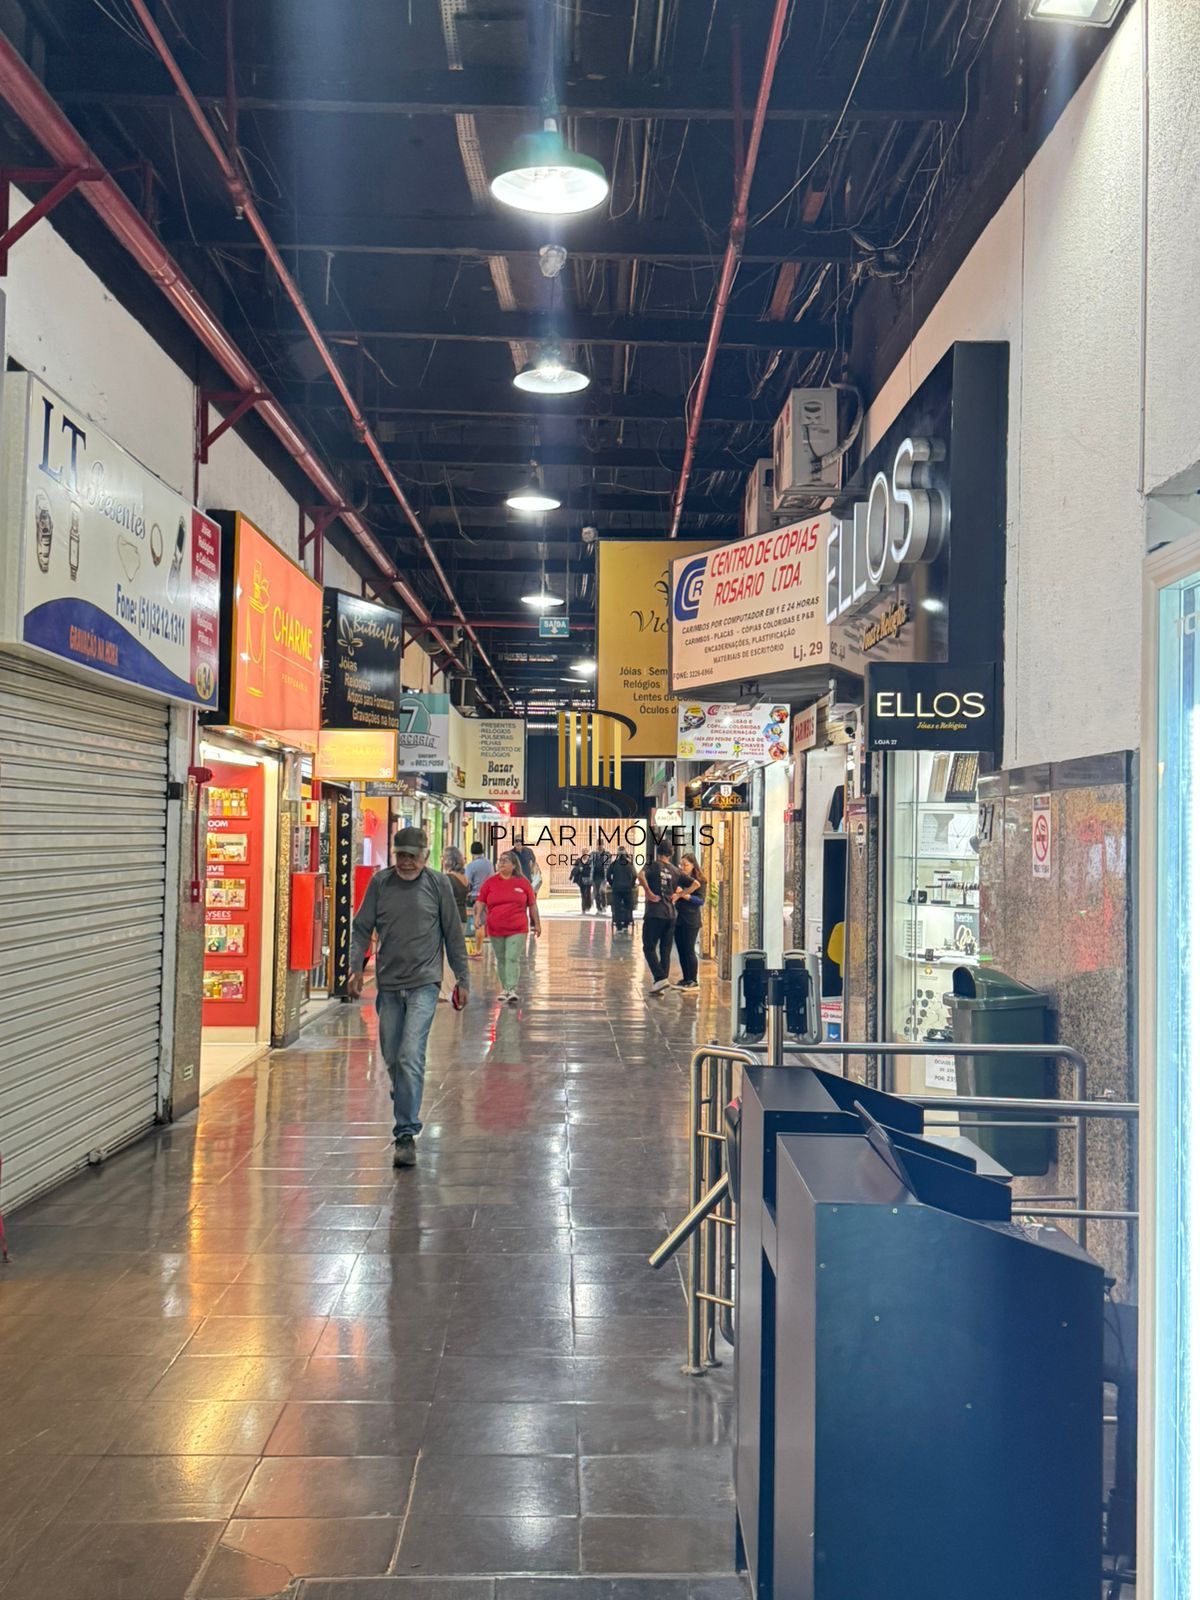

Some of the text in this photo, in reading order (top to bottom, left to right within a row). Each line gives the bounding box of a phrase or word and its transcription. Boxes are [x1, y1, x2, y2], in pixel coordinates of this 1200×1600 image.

[38, 395, 87, 496] LT
[86, 460, 146, 541] Presentes
[826, 437, 926, 625] ELLOS
[710, 543, 755, 577] CENTRO
[755, 536, 773, 566] DE
[771, 561, 802, 592] LTDA.
[116, 584, 137, 625] Fone:
[682, 622, 710, 635] CARIMBOS
[711, 619, 723, 629] POR
[723, 610, 764, 626] COMPUTADOR
[764, 607, 775, 618] EM
[781, 605, 786, 613] E
[787, 602, 795, 612] 24
[796, 596, 820, 610] HORAS
[273, 606, 314, 661] CHARME
[543, 618, 567, 628] SAÍDA
[685, 636, 710, 646] CARIMBOS
[713, 630, 734, 640] PLACAS
[762, 617, 796, 631] COLORIDAS
[796, 615, 800, 623] E
[713, 652, 742, 664] MATERIAIS
[742, 650, 750, 658] DE
[809, 641, 823, 657] 29
[623, 679, 661, 691] Relógios
[633, 692, 662, 702] Lentes
[352, 706, 381, 726] Gravações
[639, 704, 669, 715] Óculos
[876, 692, 986, 718] ELLOS
[488, 761, 514, 773] Bazar
[482, 774, 520, 789] Brumely
